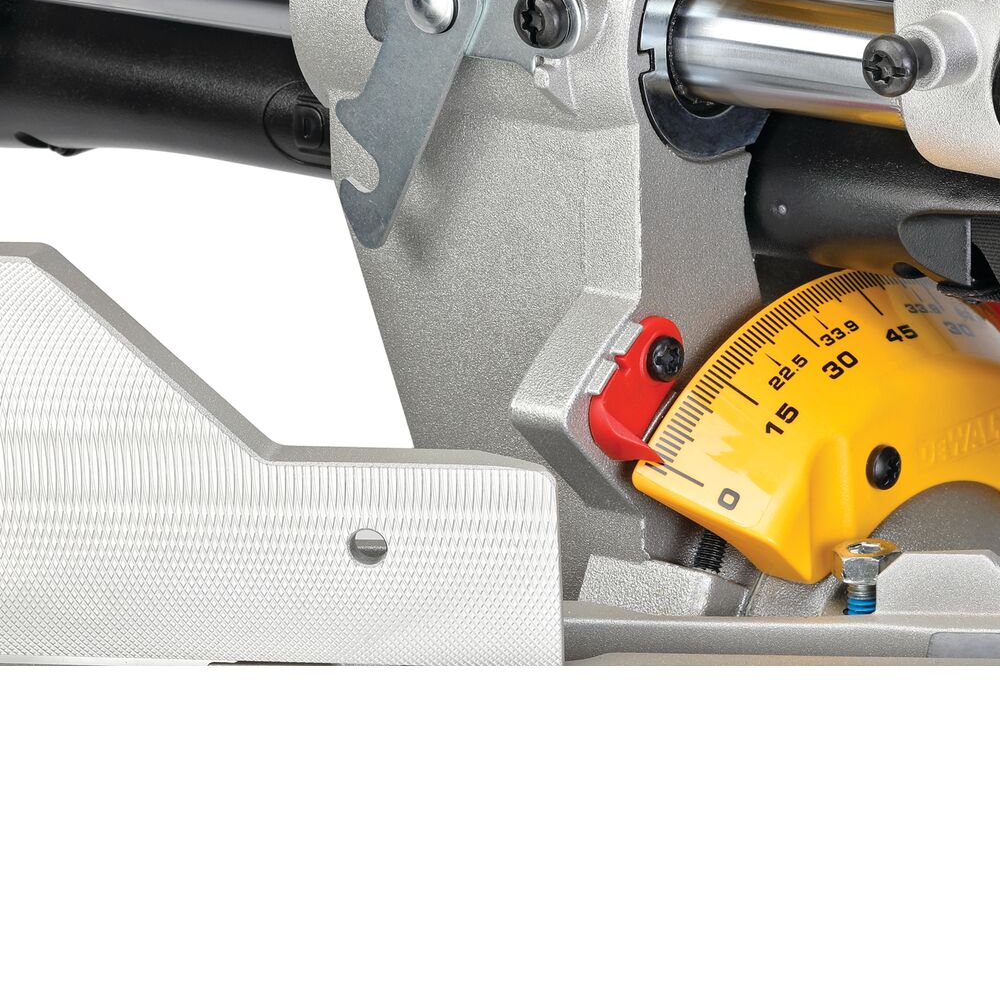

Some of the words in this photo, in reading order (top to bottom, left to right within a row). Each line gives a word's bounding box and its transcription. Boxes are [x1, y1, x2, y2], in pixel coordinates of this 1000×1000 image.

[820, 320, 860, 347] 33.9
[886, 324, 918, 342] 45
[768, 354, 808, 391] 22.5
[822, 350, 859, 380] 30
[765, 402, 800, 435] 15
[717, 487, 740, 511] 0
